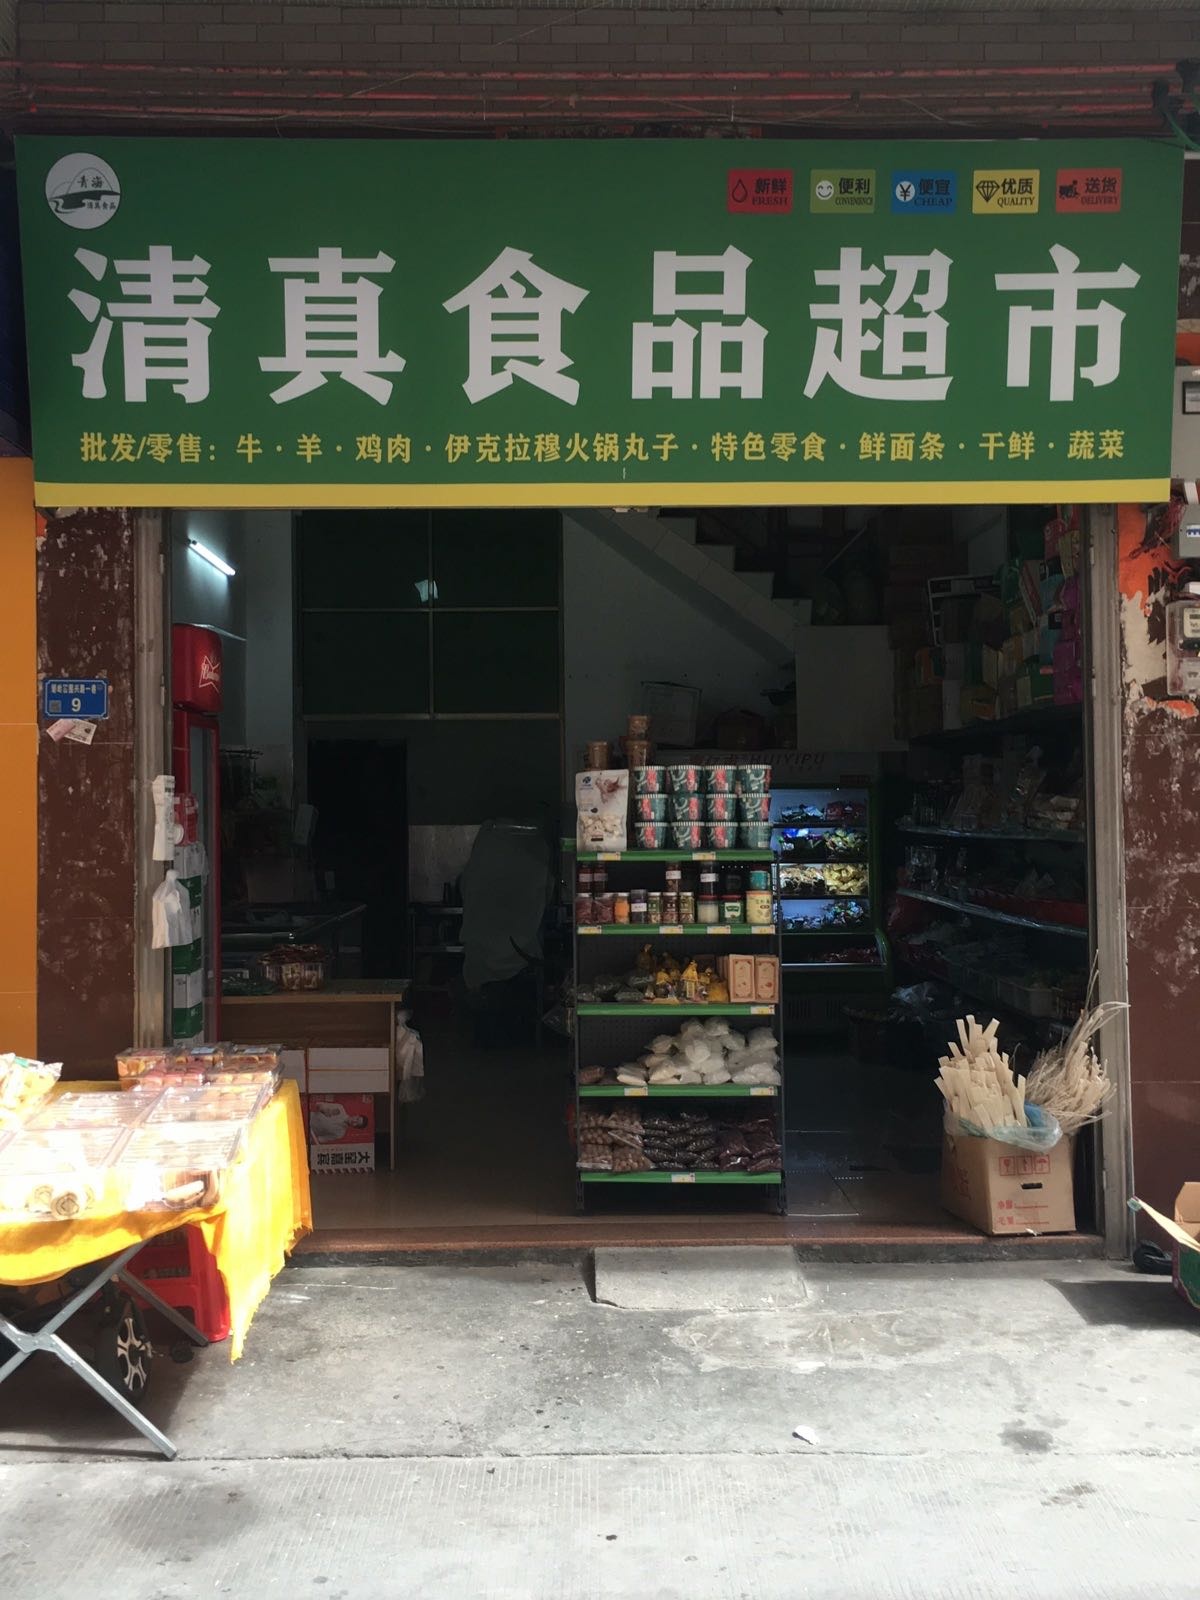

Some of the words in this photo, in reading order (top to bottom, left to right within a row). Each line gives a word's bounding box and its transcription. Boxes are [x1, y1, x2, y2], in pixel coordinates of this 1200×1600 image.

[755, 177, 787, 194] 新鲜
[838, 177, 871, 195] 便利
[919, 178, 951, 196] 便宜
[1001, 178, 1034, 196] 优质
[1085, 177, 1117, 194] 送货
[752, 196, 787, 206] FRESH
[914, 198, 953, 208] CHEAP
[997, 197, 1035, 208] QUALITY
[67, 243, 1141, 406] 清真食品超市
[71, 698, 81, 712] 9
